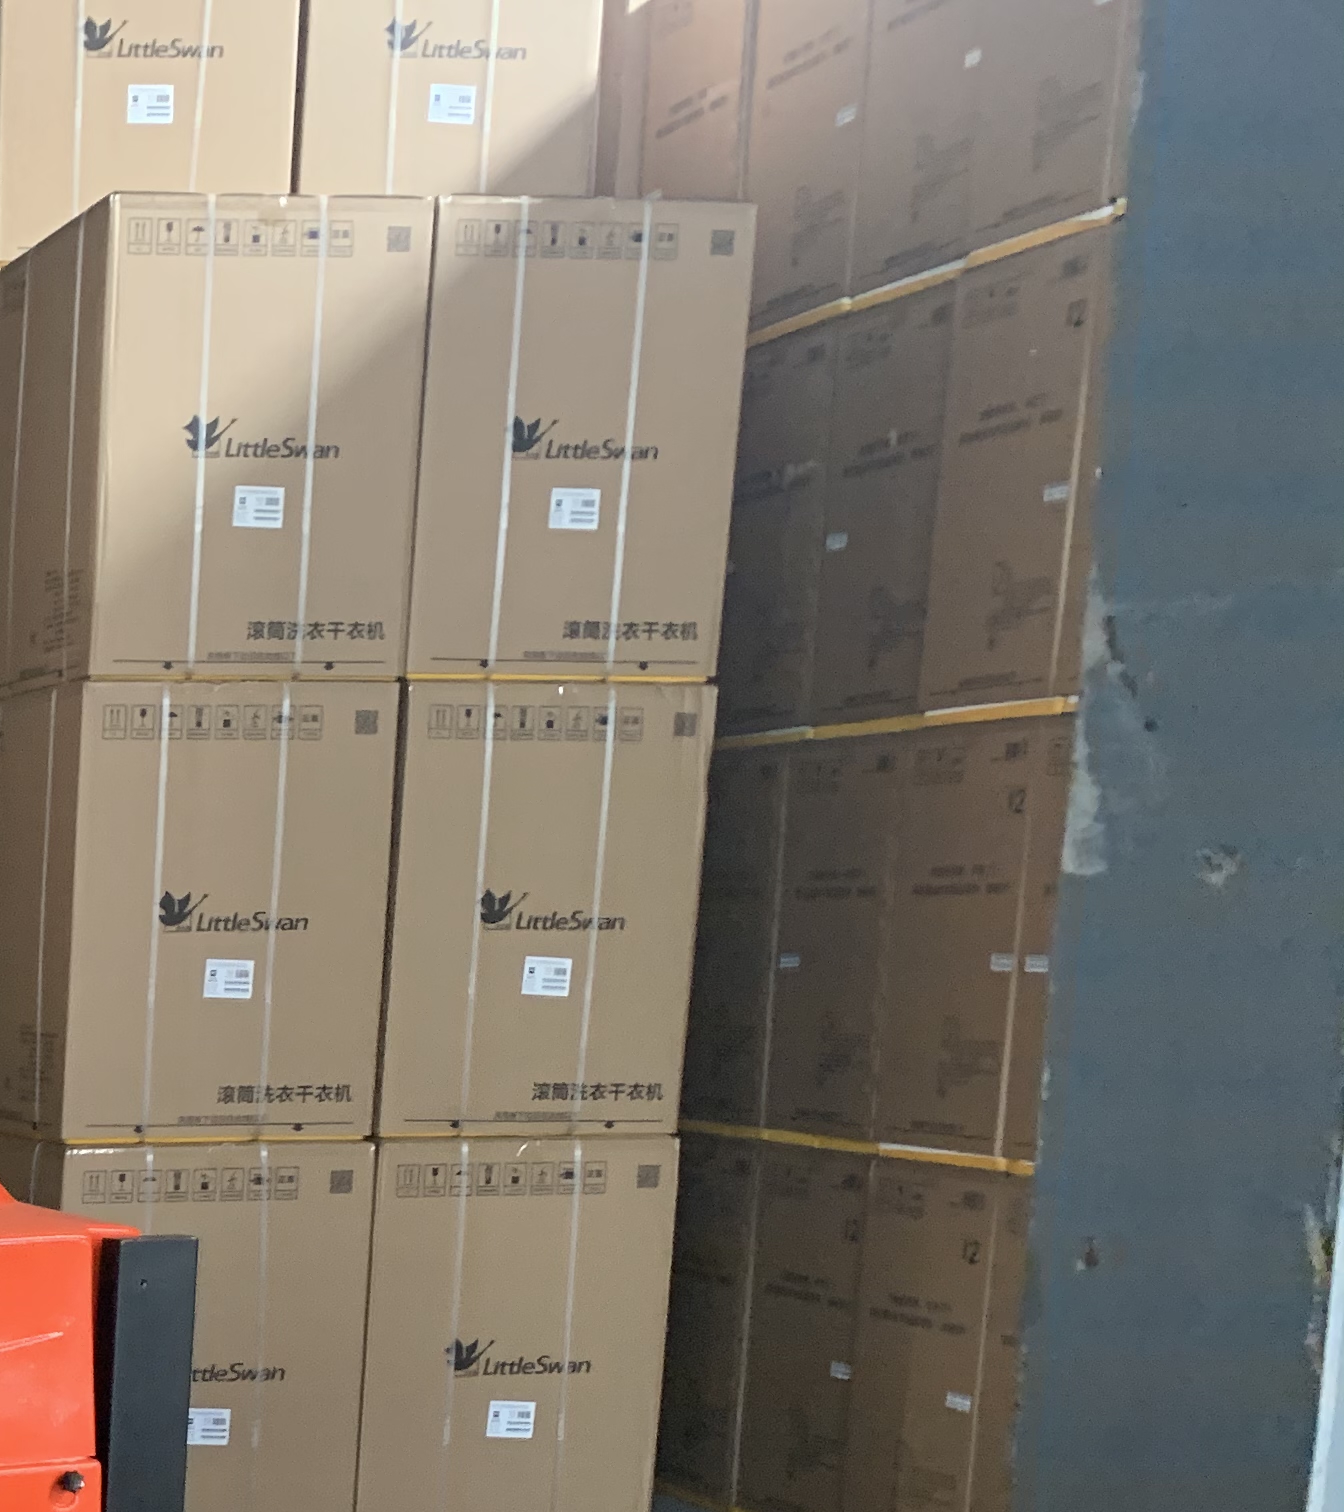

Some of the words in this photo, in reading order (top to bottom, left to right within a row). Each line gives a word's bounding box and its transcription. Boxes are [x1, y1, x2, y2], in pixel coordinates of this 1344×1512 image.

[117, 37, 223, 60] LittleSwan
[224, 440, 339, 460] LittleSwan
[545, 440, 658, 461] LittleSwan
[196, 912, 309, 933] LittleSwan
[515, 911, 626, 932] LittleSwan
[217, 1084, 353, 1105] 滚筒洗衣干衣机
[531, 1081, 664, 1102] 滚筒洗衣干衣机
[482, 1355, 592, 1377] LittleSwan
